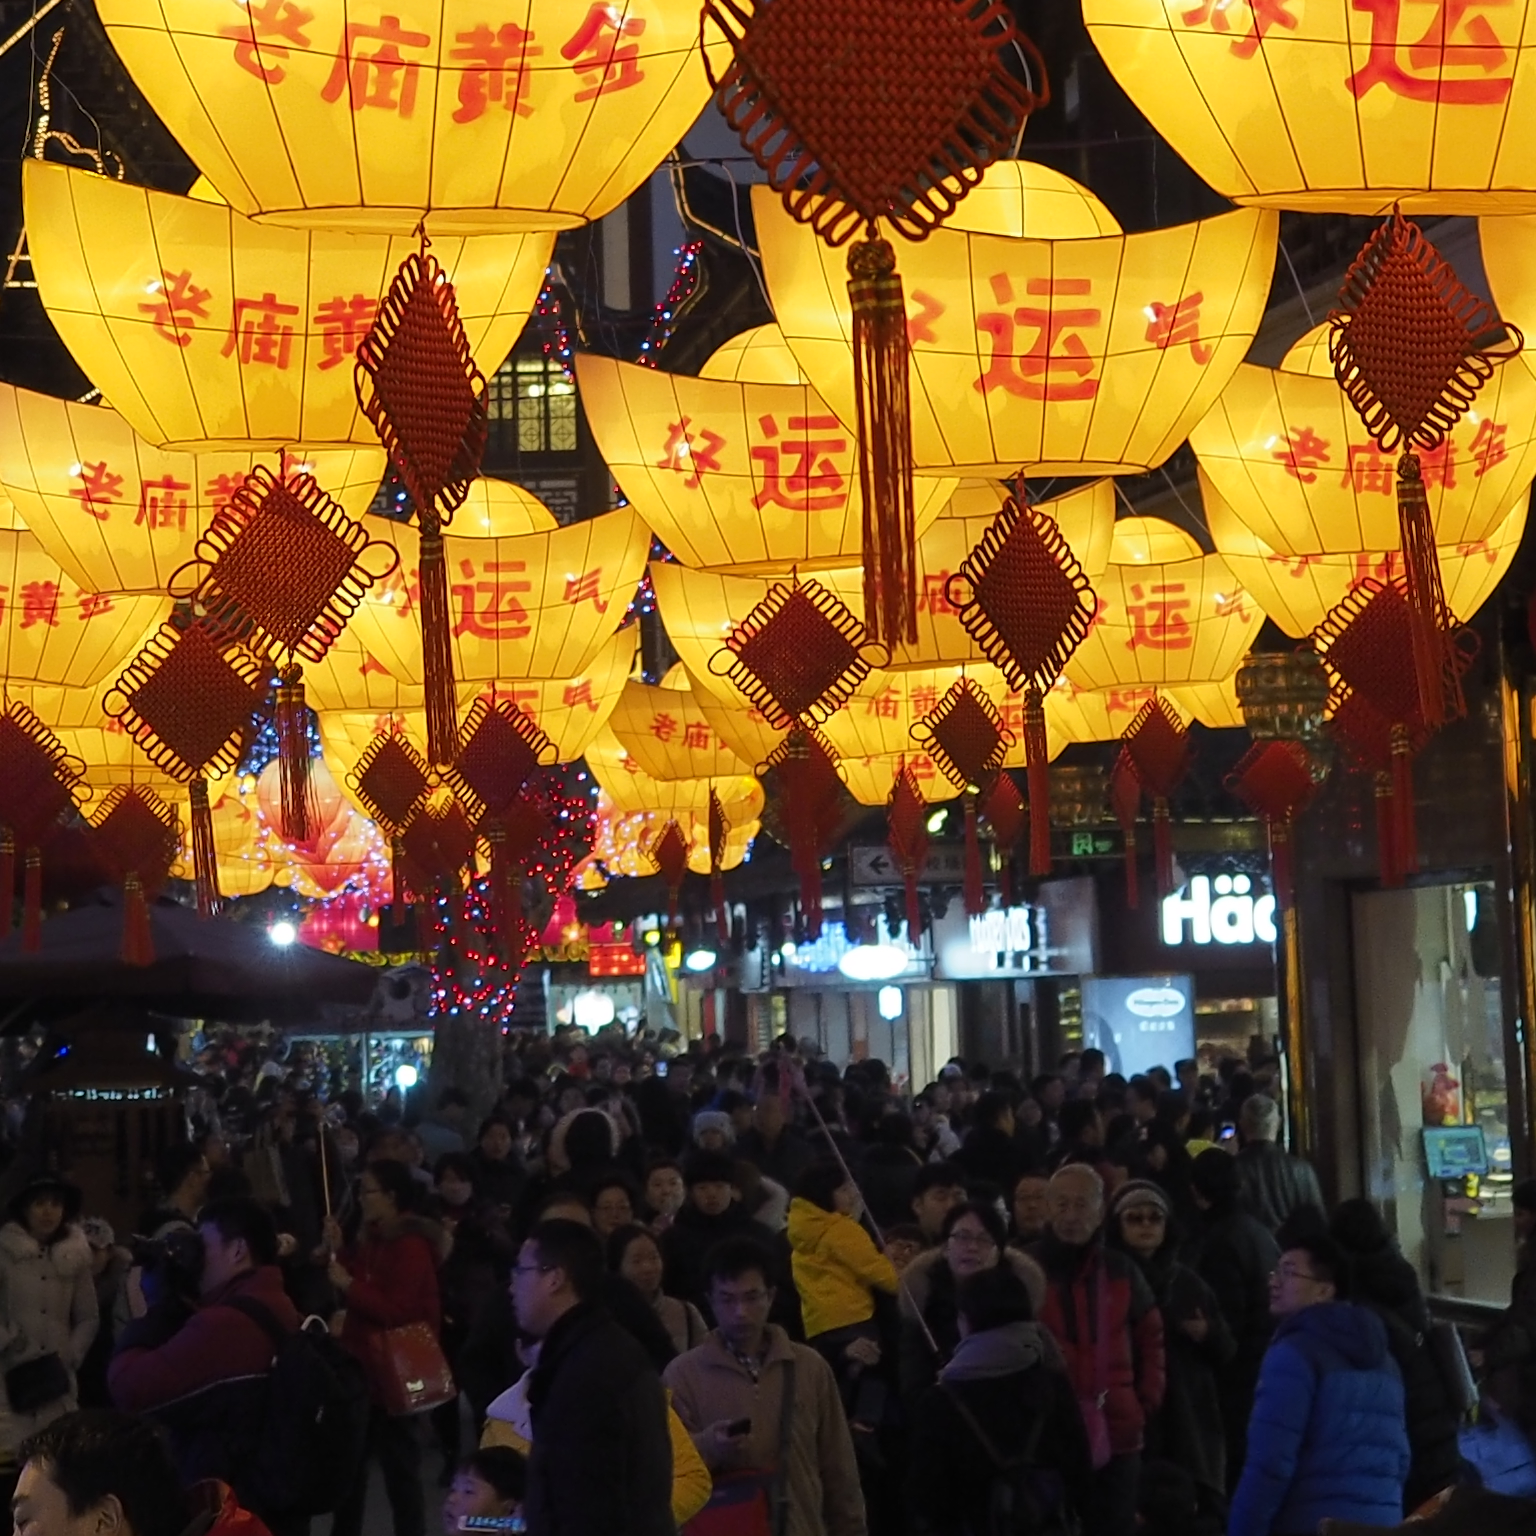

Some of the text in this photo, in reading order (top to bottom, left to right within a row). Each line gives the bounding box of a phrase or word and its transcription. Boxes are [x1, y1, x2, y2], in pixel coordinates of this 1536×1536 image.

[138, 268, 456, 371] 老庙黄
[1272, 418, 1509, 496] 老庙黄金
